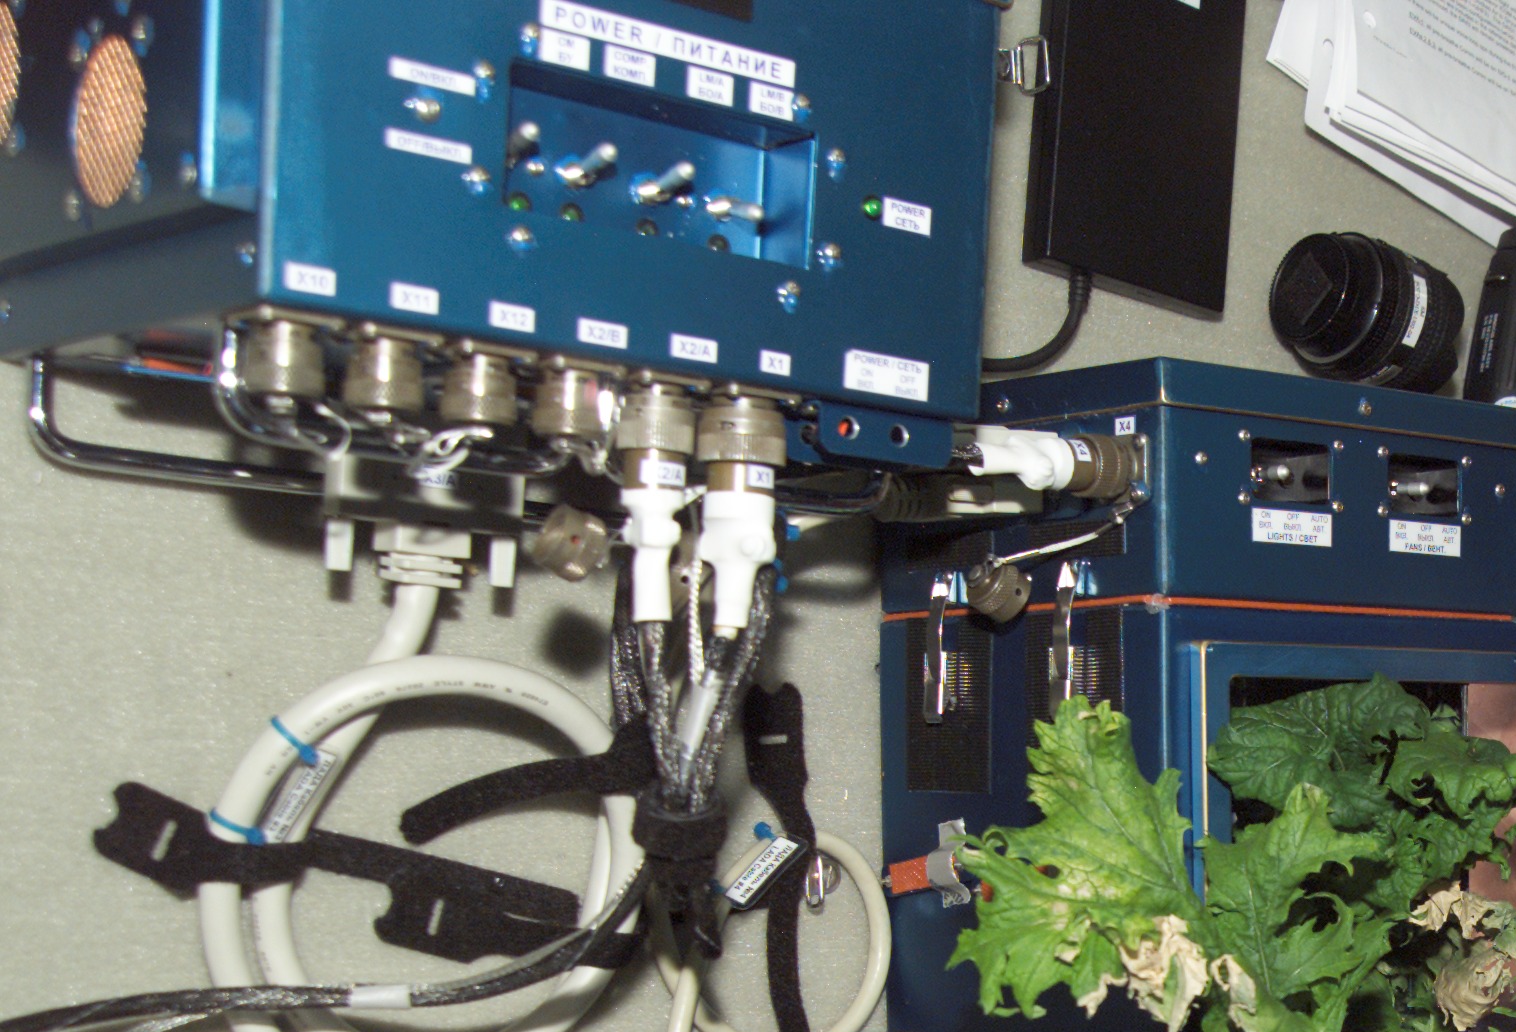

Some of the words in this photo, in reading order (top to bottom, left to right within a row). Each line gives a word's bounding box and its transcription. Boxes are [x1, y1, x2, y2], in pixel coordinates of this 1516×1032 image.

[555, 6, 643, 45] POWER
[673, 36, 782, 80] ПИТАНИЕ
[892, 202, 925, 218] POWER
[896, 217, 920, 231] СЕТЬ
[680, 340, 712, 358] X2/A
[768, 356, 783, 371] X1
[1119, 421, 1131, 432] X4
[756, 468, 772, 484] X1
[1311, 515, 1329, 523] AUTO
[1267, 532, 1294, 541] LIGHTS
[1299, 535, 1318, 543] СВЕТ
[1442, 527, 1458, 535] AUTO
[1405, 543, 1423, 551] FANS
[759, 845, 779, 863] LADA
[741, 863, 762, 881] Cable
